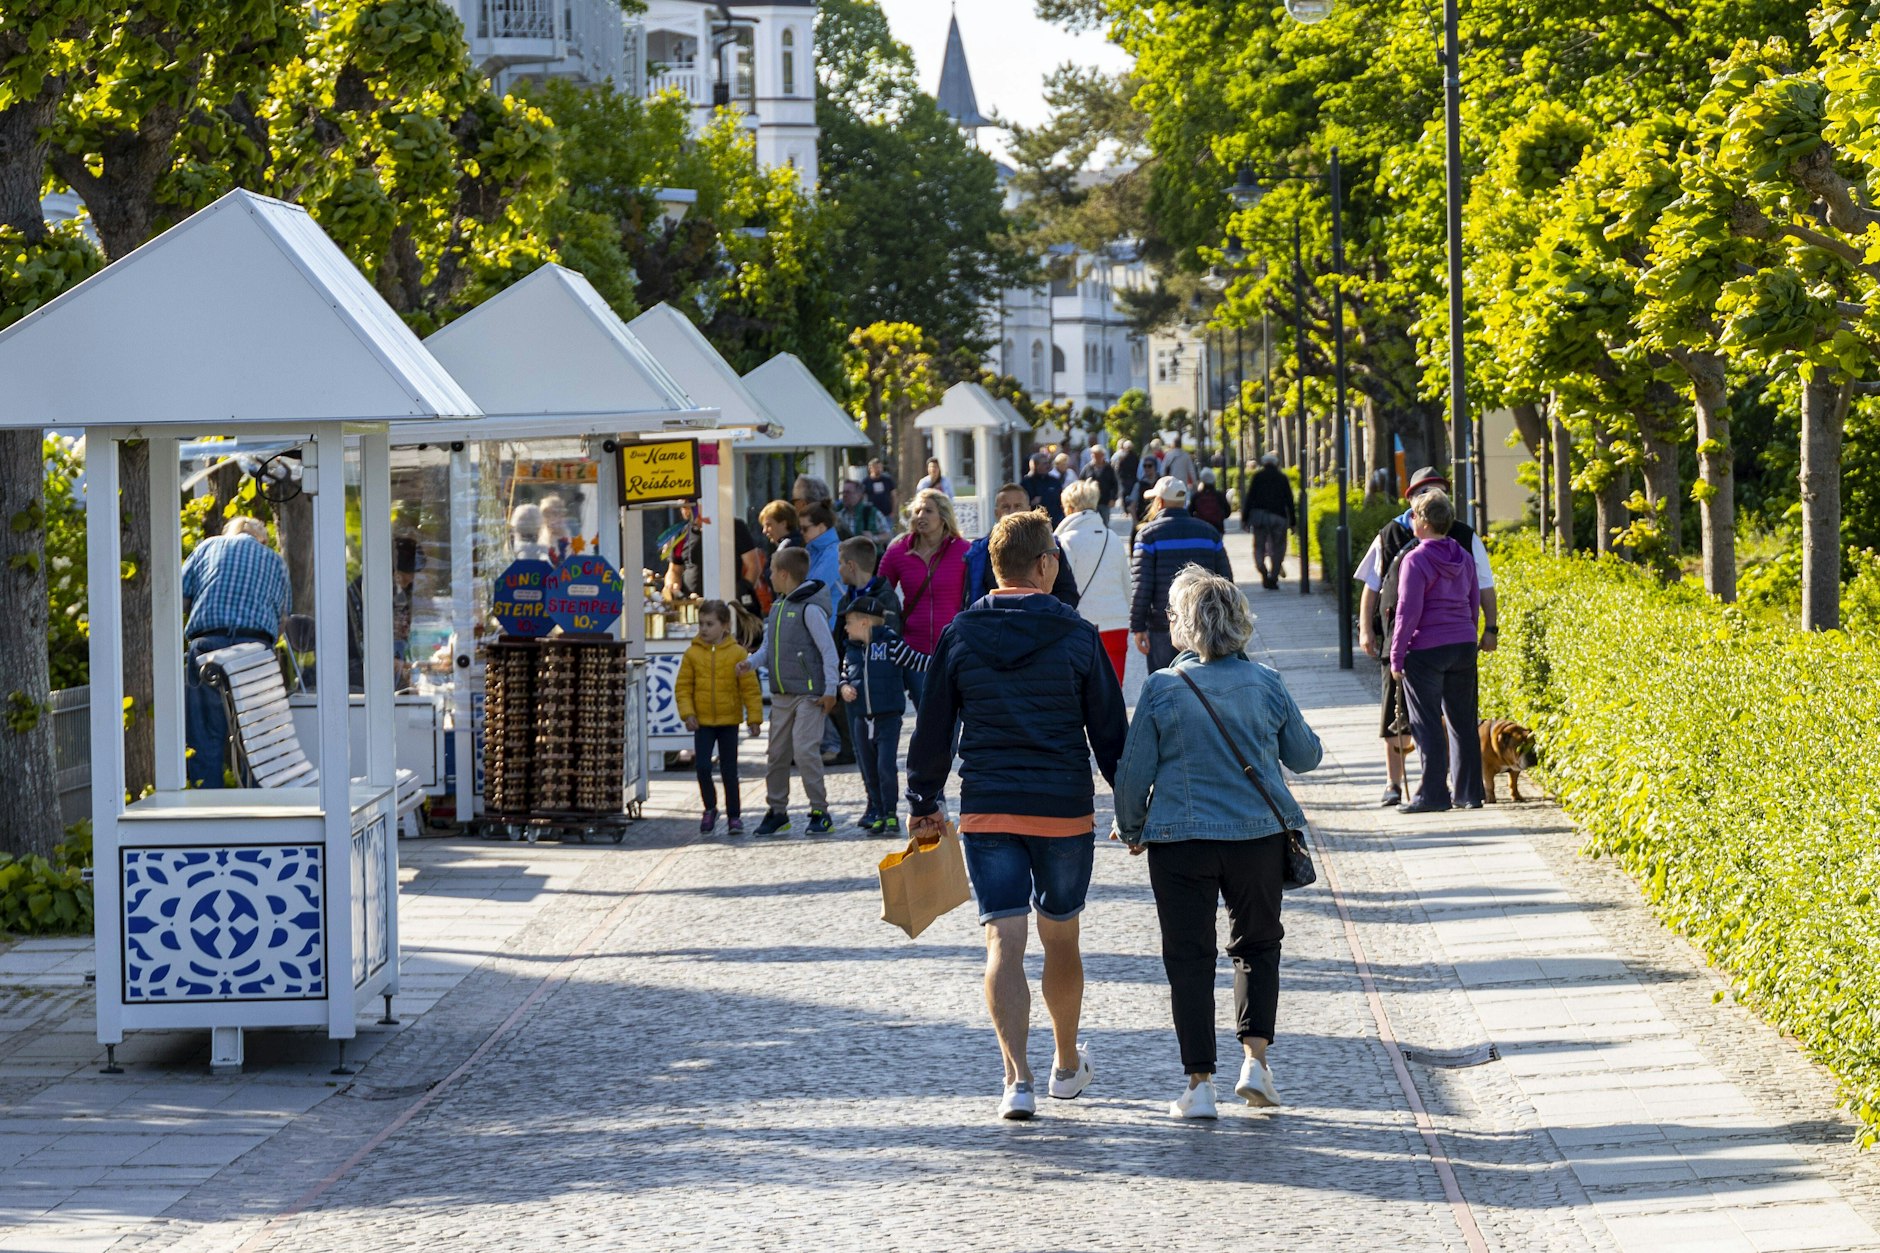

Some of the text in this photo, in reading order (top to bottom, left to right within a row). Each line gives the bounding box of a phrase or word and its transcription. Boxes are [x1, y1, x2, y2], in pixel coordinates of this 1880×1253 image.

[643, 447, 688, 464] Name
[627, 475, 693, 496] Reiskorn
[494, 601, 550, 618] STEMP
[548, 598, 623, 615] STEMPEL
[870, 642, 888, 661] M
